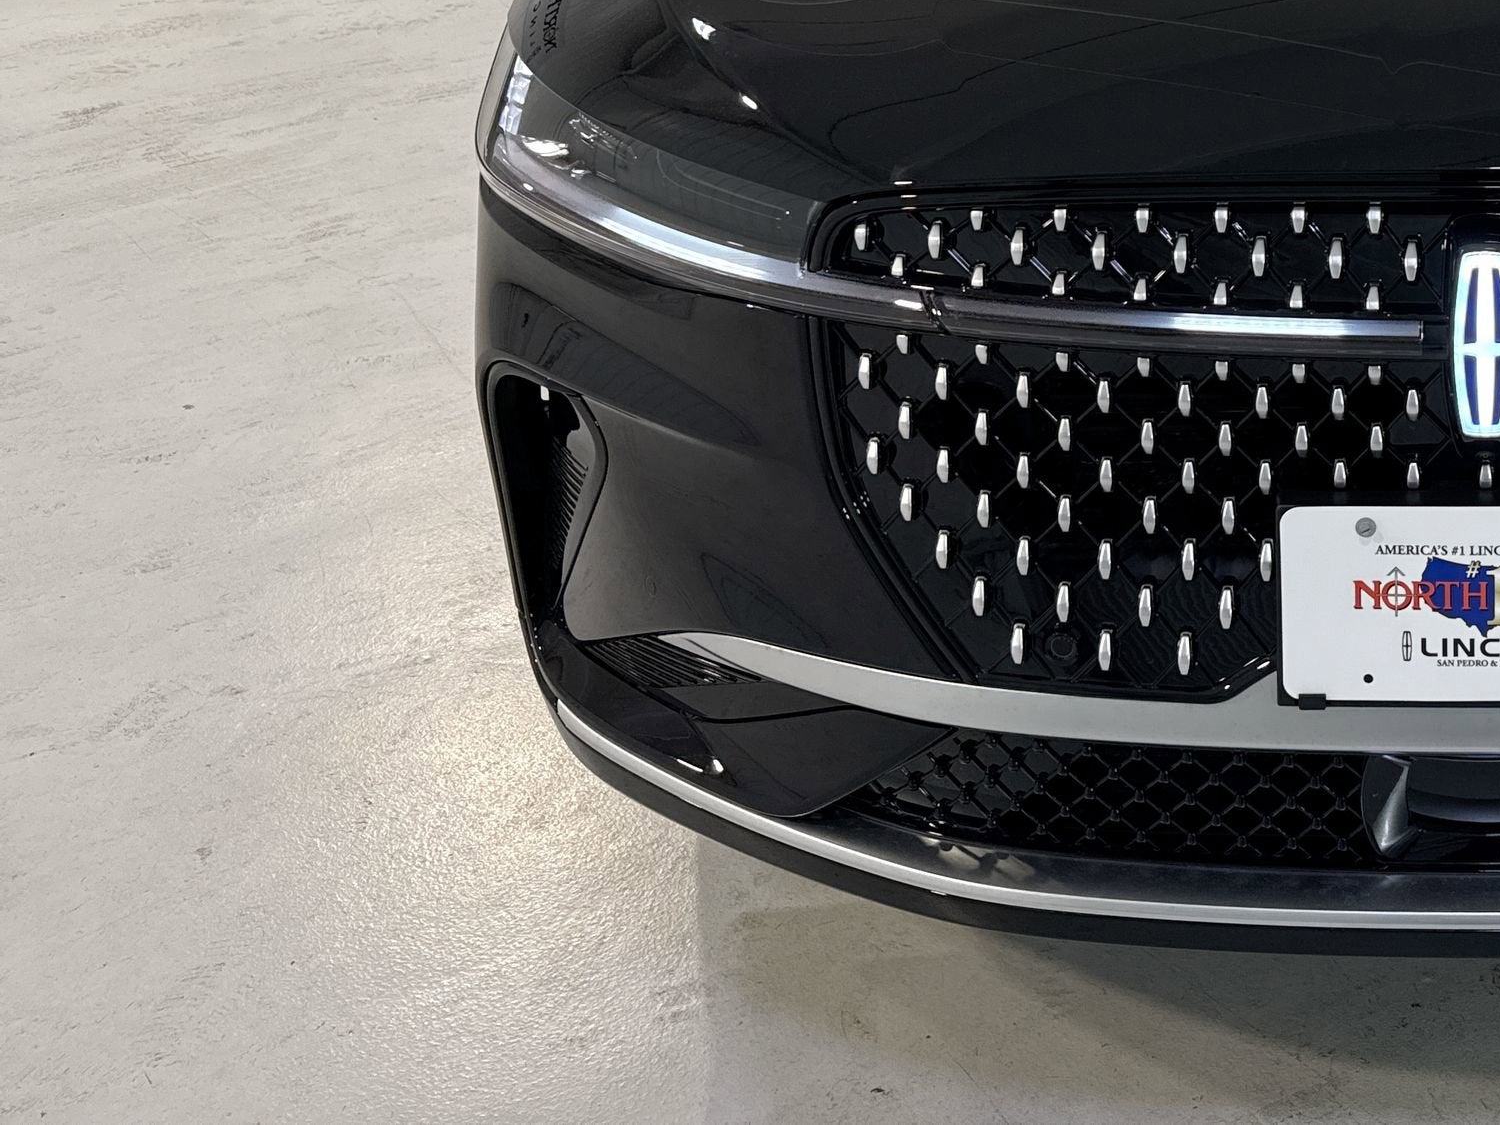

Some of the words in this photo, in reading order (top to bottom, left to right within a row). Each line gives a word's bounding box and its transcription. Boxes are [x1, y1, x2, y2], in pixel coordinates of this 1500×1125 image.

[1374, 544, 1449, 556] AMERICA'S
[1451, 545, 1466, 556] #1
[1352, 579, 1489, 611] NORTH
[1437, 659, 1455, 668] SAN
[1456, 659, 1489, 668] PEDRO
[1490, 659, 1499, 668] &
